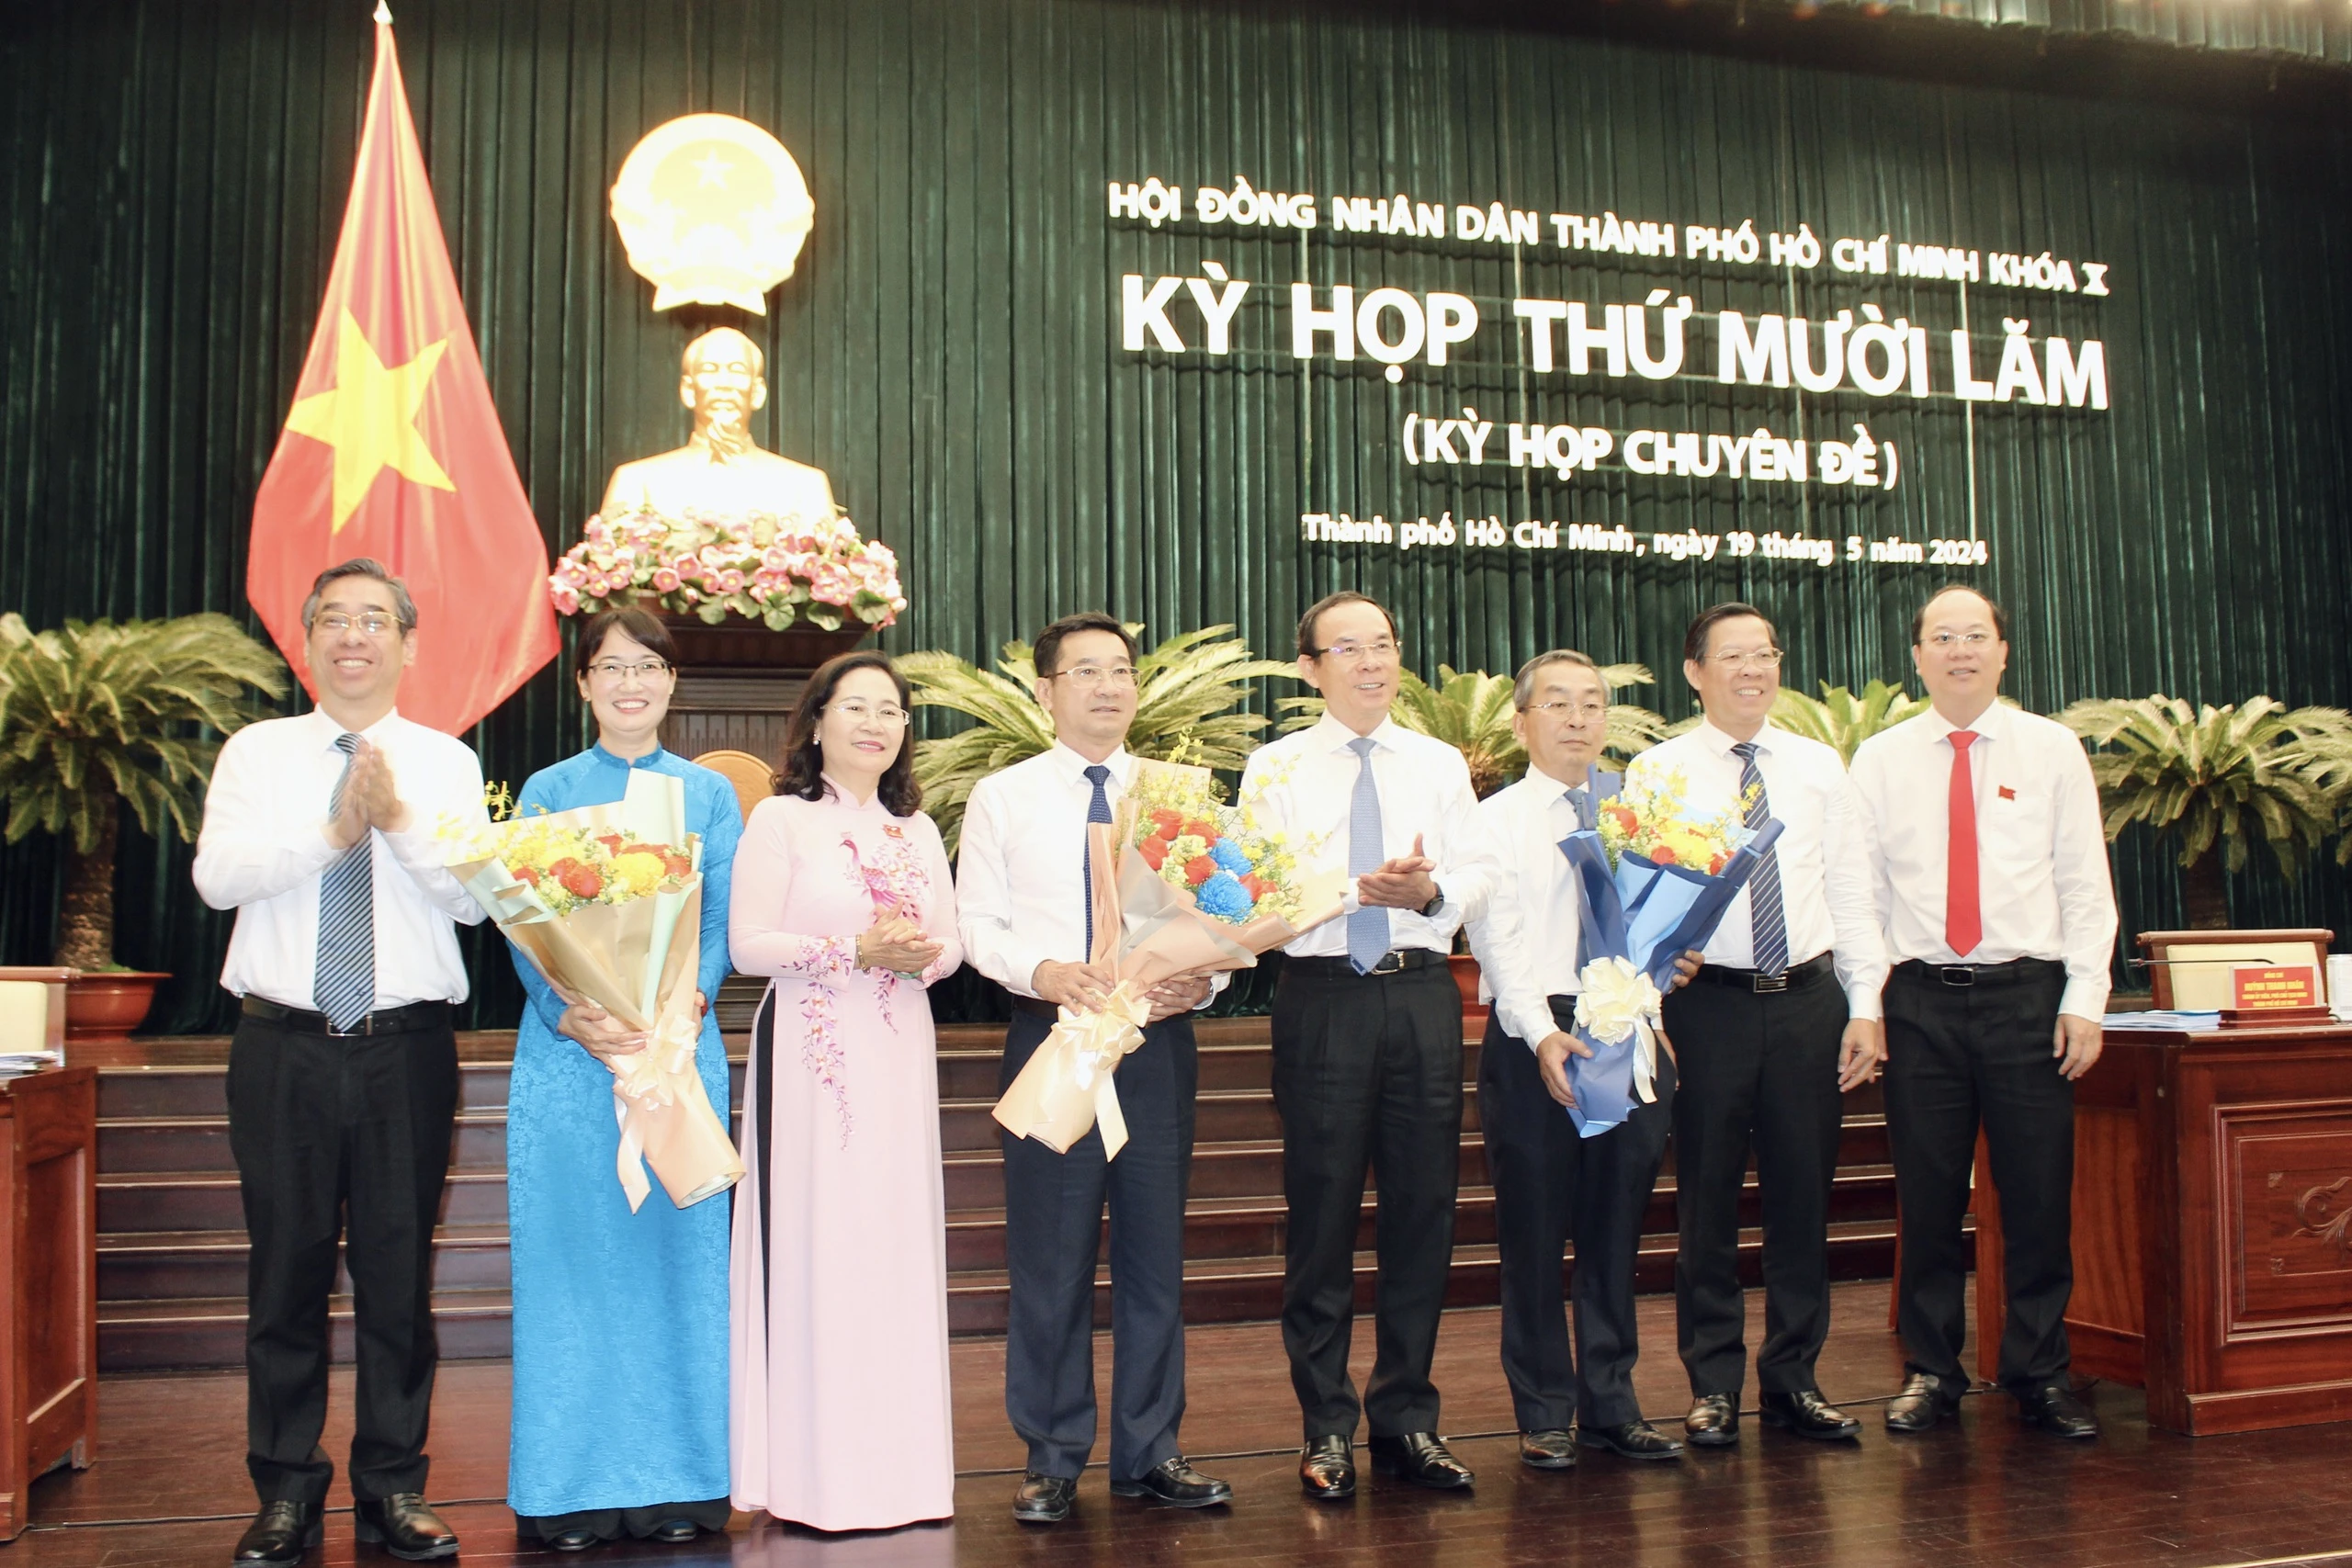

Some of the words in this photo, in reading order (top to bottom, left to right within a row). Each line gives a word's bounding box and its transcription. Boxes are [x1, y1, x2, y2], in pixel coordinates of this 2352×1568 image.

[1109, 177, 1182, 228] HỘI
[1195, 175, 1317, 229] ĐỒNG
[1332, 195, 1444, 238] NHÂN
[1456, 201, 1539, 245] DÂN
[1550, 211, 1676, 257] THÀNH
[1686, 219, 1759, 265] PHỐ
[1770, 223, 1821, 268] HỒ
[1831, 234, 1889, 274] CHÍ
[1897, 243, 1979, 282] MINH
[1988, 251, 2076, 292] KHÓA
[2082, 261, 2109, 296] X
[1123, 261, 1250, 355] KỲ
[1291, 283, 1478, 384] HỌP
[1513, 289, 1693, 380] THỨ
[1718, 303, 1928, 399] MƯỜI
[1951, 317, 2109, 411] LĂM
[1403, 407, 1493, 466] (KỲ
[1509, 423, 1613, 481] HỌP
[1623, 427, 1807, 483] CHUYÊN
[1817, 423, 1898, 491] ĐỀ)
[1301, 513, 1392, 544] Thành
[1400, 511, 1456, 550] phố
[1465, 514, 1506, 547] Hồ
[1513, 521, 1559, 549] Chí
[1568, 524, 1645, 558] Minh,
[1654, 528, 1719, 561] ngày
[1726, 531, 1755, 557] 19
[1760, 531, 1834, 567] tháng
[1846, 536, 1862, 561] 5
[1870, 536, 1923, 563] năm
[1928, 538, 1988, 566] 2024
